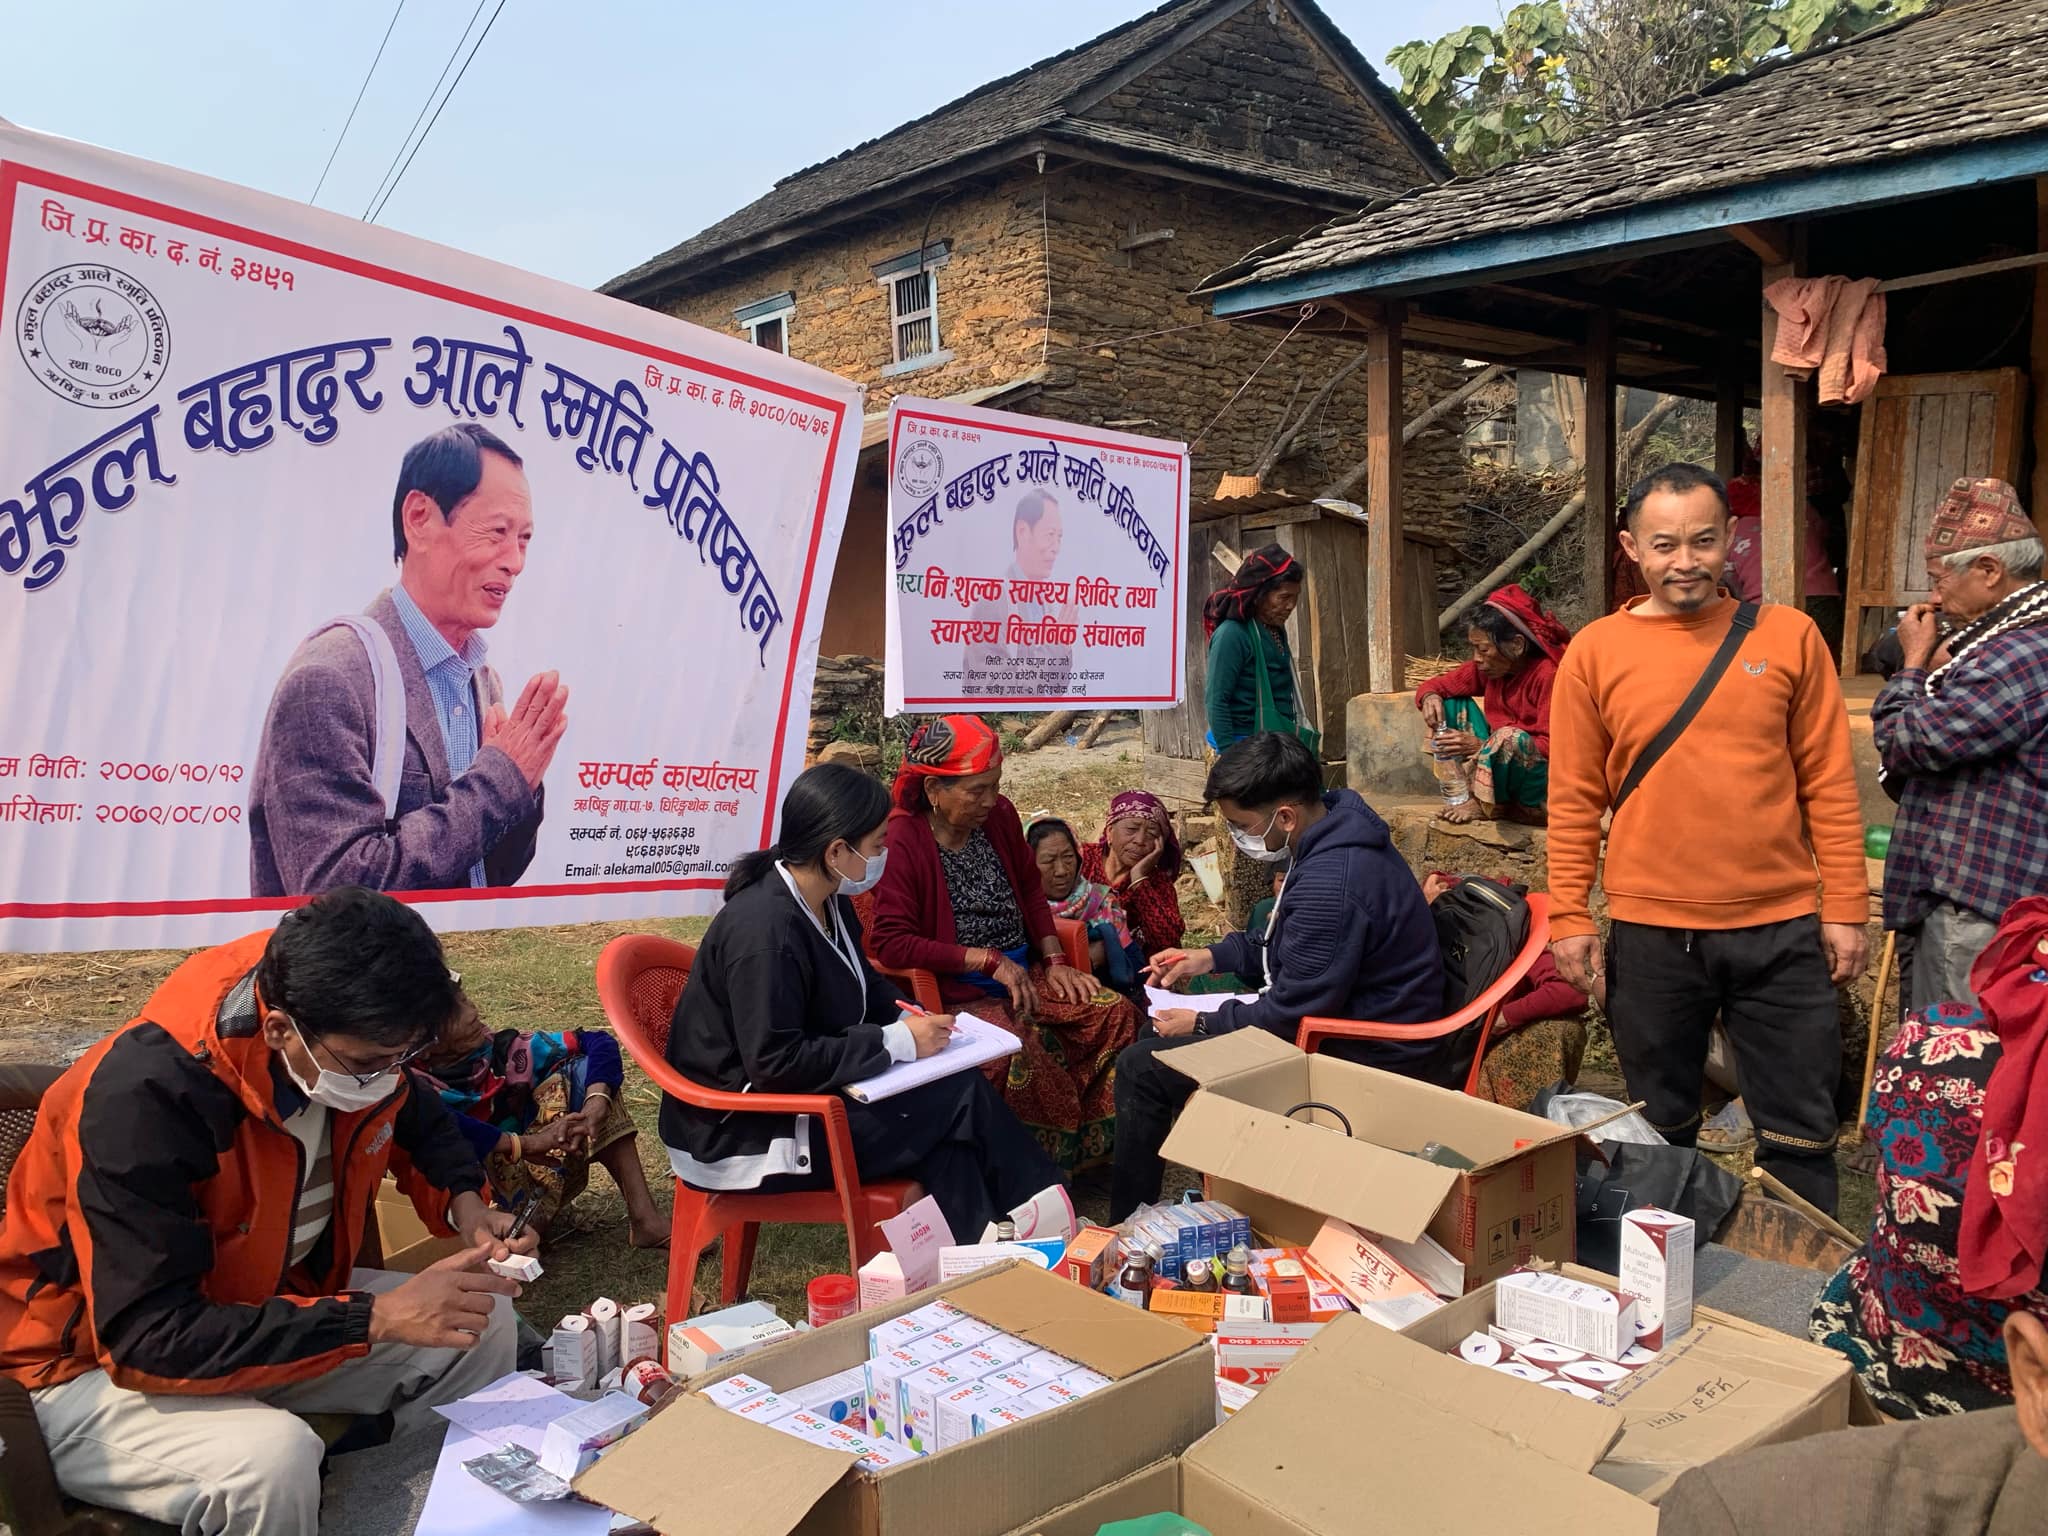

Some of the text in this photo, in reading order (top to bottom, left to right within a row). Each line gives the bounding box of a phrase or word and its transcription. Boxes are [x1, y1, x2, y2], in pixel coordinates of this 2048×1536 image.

[177, 337, 393, 455] बहादुर
[403, 325, 534, 429] आले
[540, 363, 655, 492] स्मृति
[643, 438, 783, 668] प्रतिष्ठान
[944, 453, 1013, 511] बहादुर
[1017, 441, 1060, 487] आले
[1064, 454, 1106, 508] स्मृति
[1103, 482, 1170, 588] प्रतिष्ठान
[1008, 578, 1071, 605] स्वास्थ्य
[1075, 575, 1122, 608] शिविर
[1125, 585, 1158, 609] तथा
[930, 613, 1147, 648] स्वास्थ्य क्लिनिक संचालन
[28, 753, 87, 779] मिति:
[99, 761, 244, 784] २००७/१०/१२
[578, 758, 760, 794] सम्पर्क कार्यालय
[96, 804, 241, 825] २०७९/०८/०९
[569, 825, 608, 841] सम्पर्क
[565, 863, 601, 877] Email:
